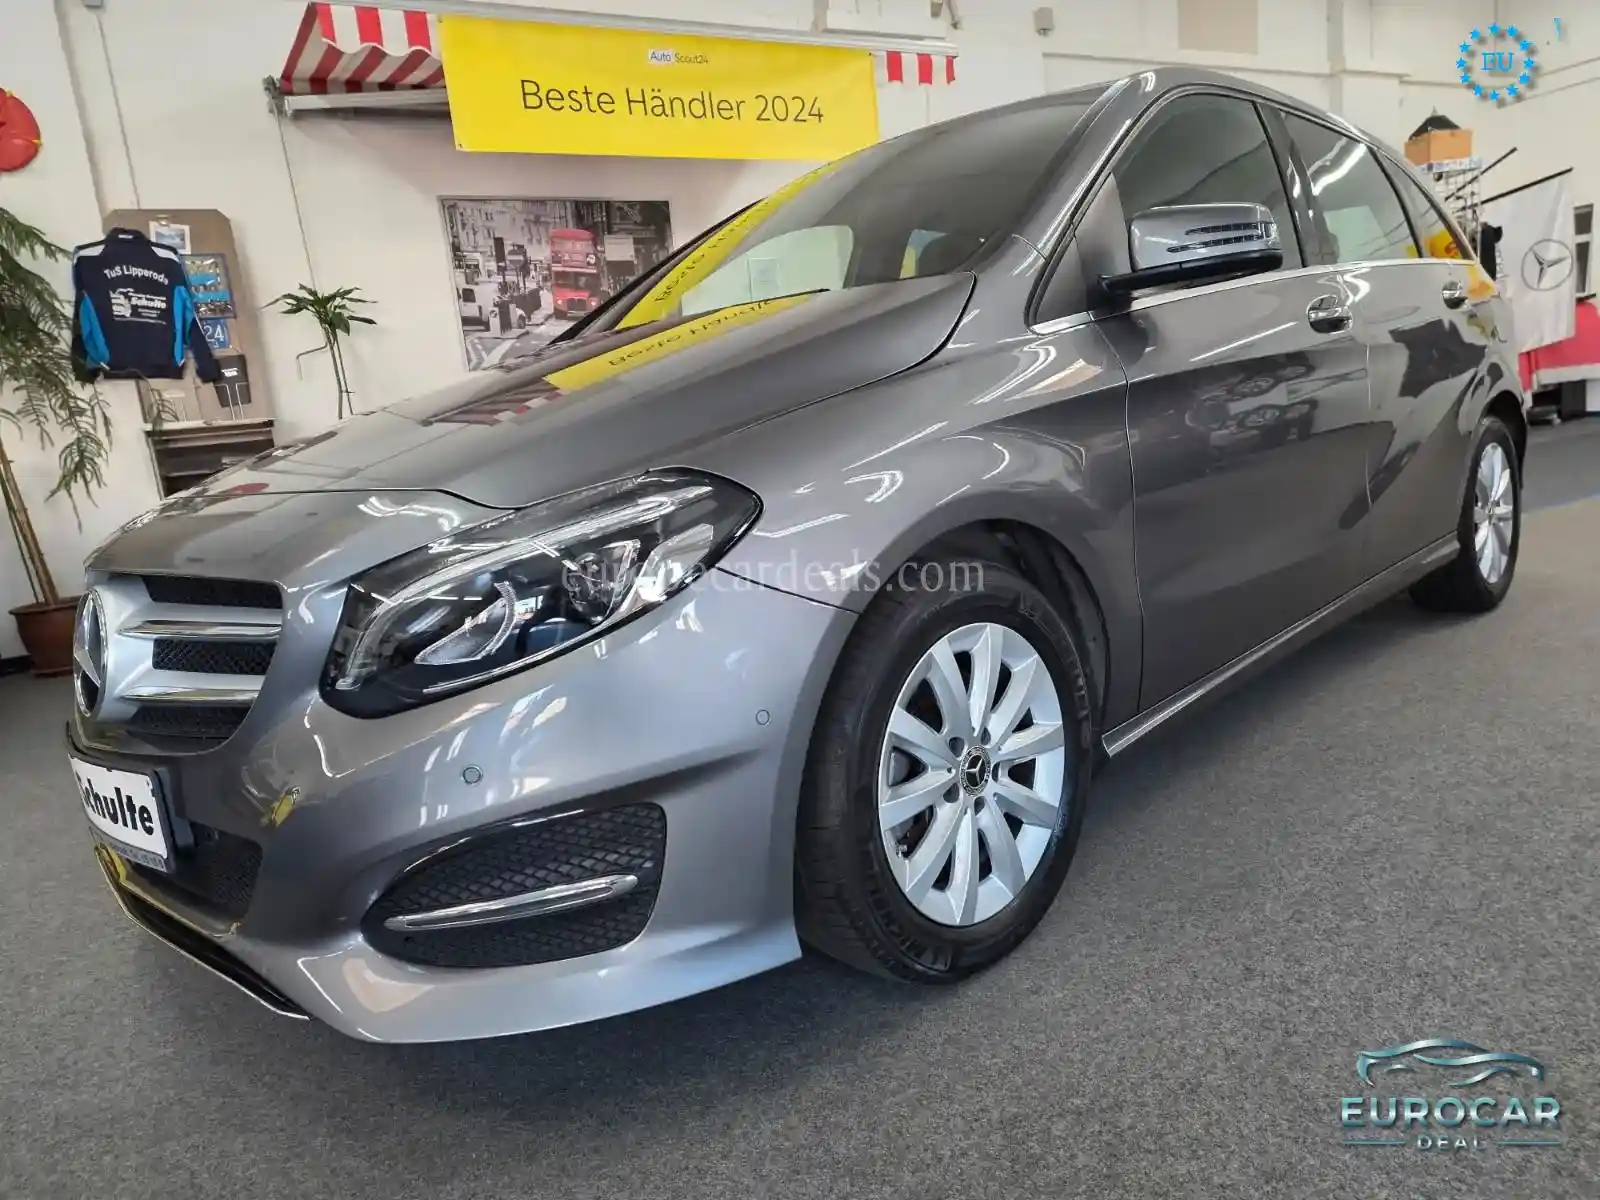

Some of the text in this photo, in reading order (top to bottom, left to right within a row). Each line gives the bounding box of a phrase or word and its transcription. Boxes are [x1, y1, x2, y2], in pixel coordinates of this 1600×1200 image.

[520, 79, 824, 124] Beste Händler 2024
[203, 324, 225, 342] 24
